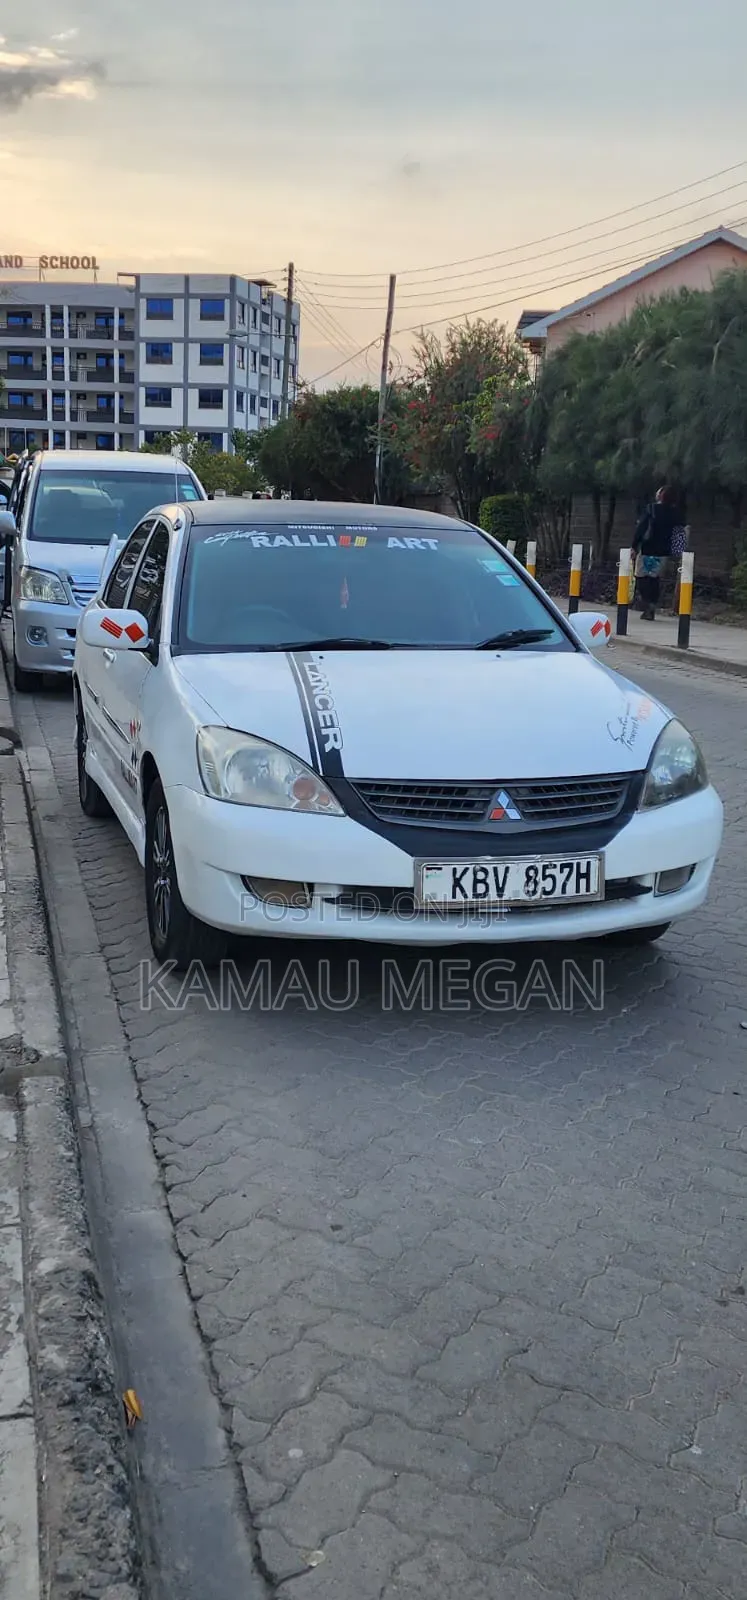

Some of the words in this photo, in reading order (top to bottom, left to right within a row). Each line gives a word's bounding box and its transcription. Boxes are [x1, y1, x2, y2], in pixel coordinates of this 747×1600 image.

[40, 255, 99, 270] SCHOOL
[251, 534, 337, 548] RALLI
[387, 536, 438, 550] ART
[304, 660, 343, 753] LANCER
[451, 865, 510, 900] KBV
[524, 860, 591, 898] 857H
